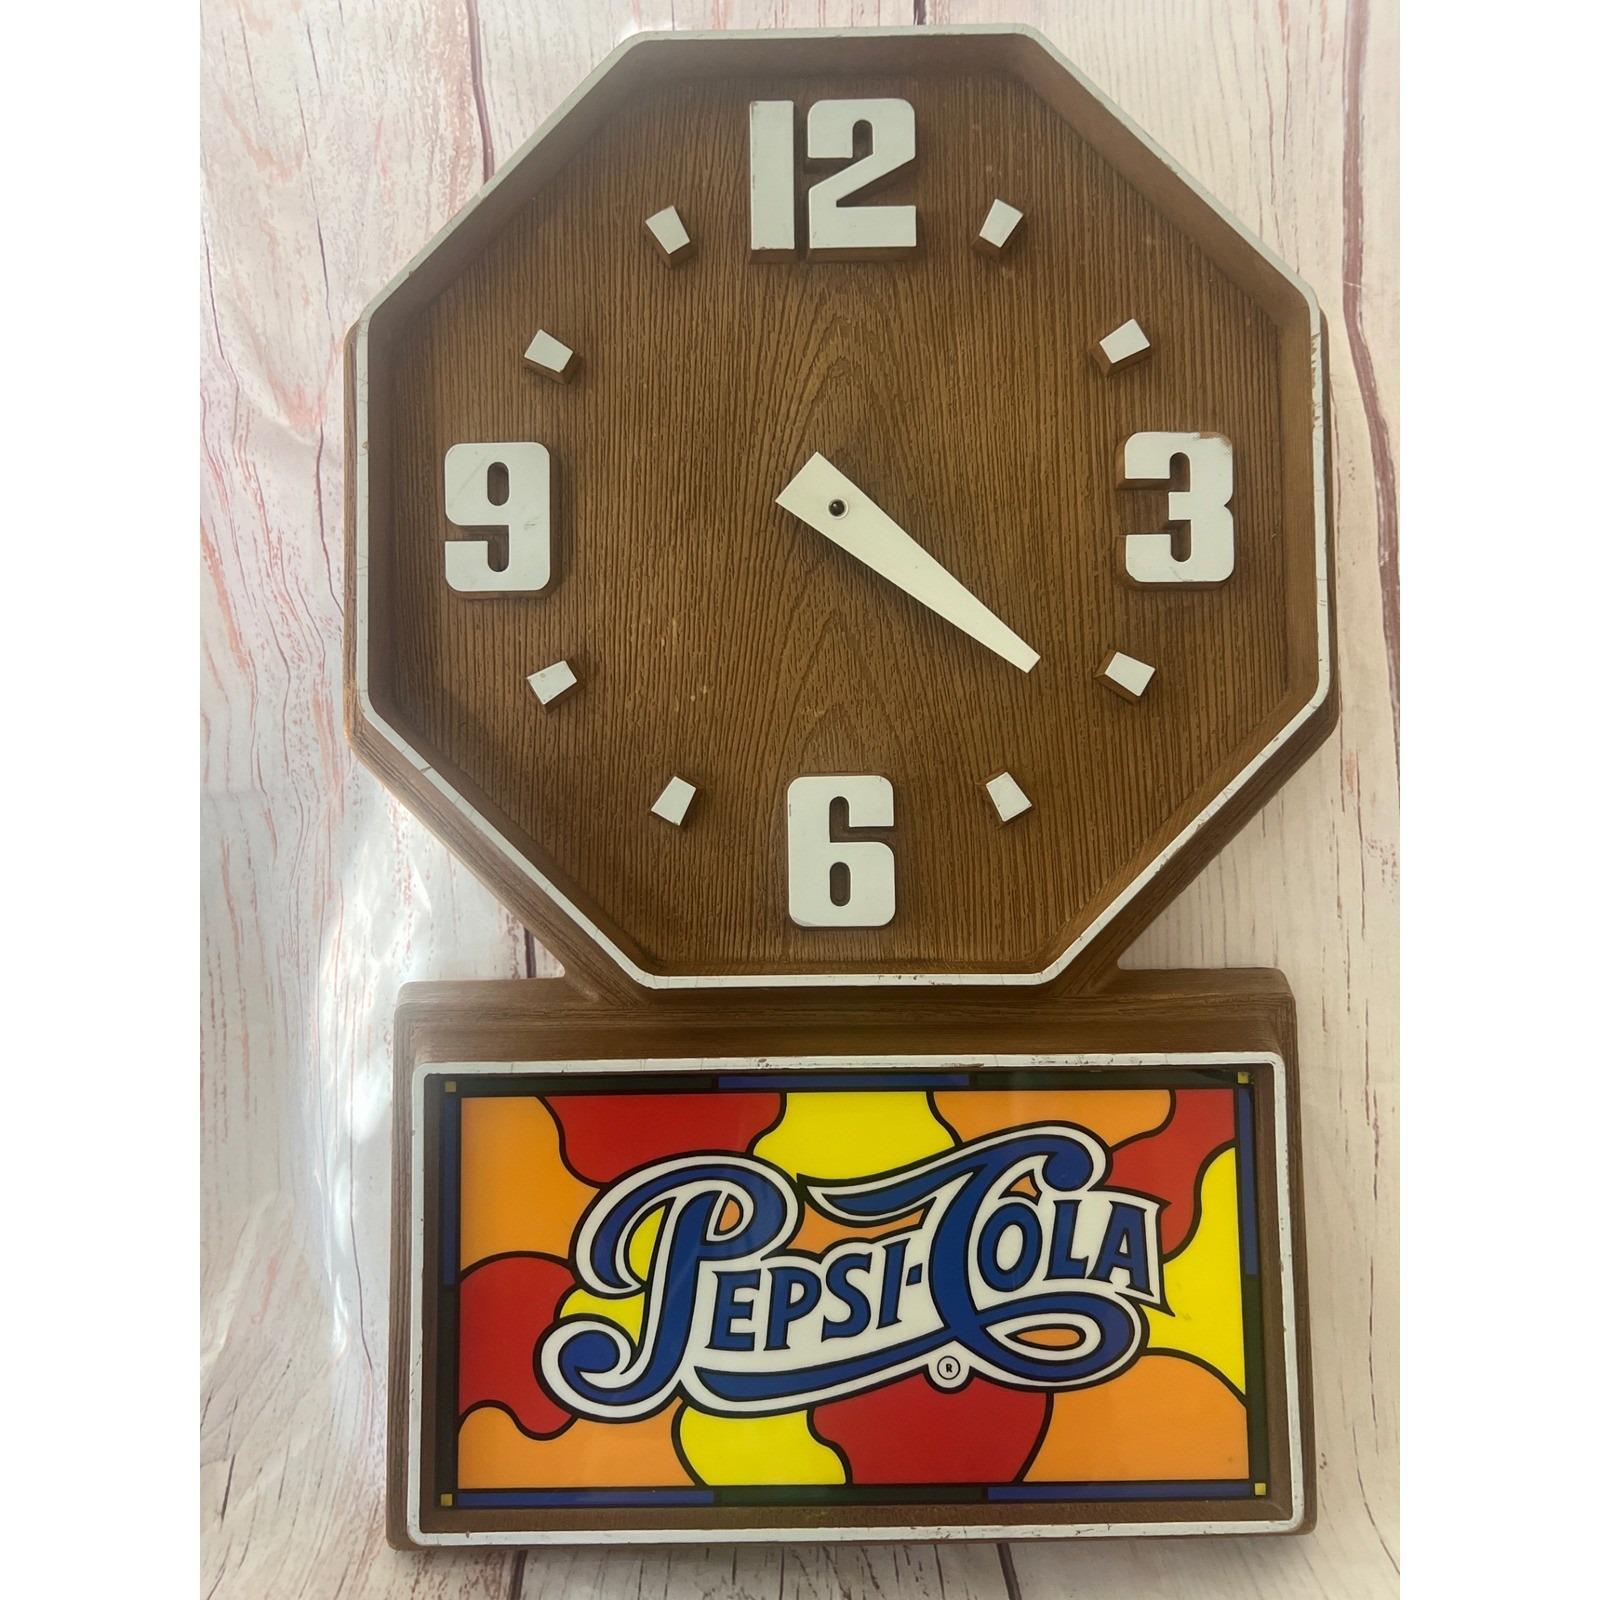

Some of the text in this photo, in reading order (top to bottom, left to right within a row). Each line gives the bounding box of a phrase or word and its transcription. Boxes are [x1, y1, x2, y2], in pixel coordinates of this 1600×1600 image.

[749, 98, 917, 250] 12
[444, 442, 551, 592] 9
[1123, 431, 1235, 583] 3
[787, 775, 896, 928] 6
